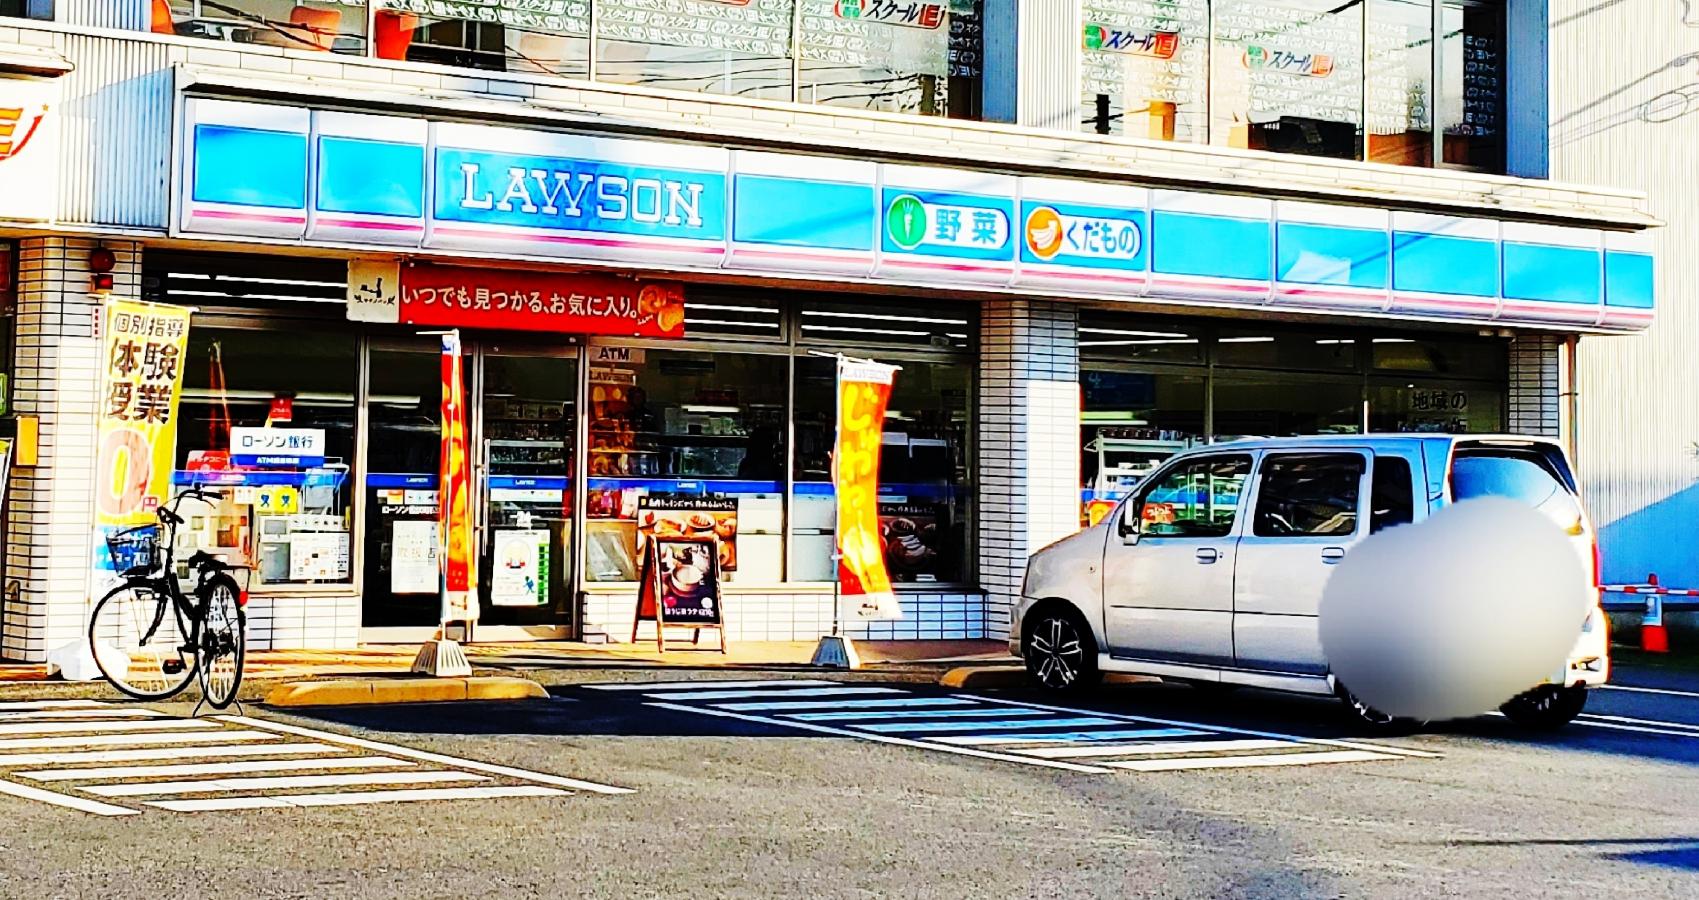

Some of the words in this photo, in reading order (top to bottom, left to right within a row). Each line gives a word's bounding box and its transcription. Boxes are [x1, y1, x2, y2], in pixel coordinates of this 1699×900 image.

[460, 162, 704, 227] LAWSON
[935, 208, 997, 244] 野菜
[1067, 222, 1136, 254] くだもの
[402, 284, 637, 319] いつでも見つかる、お気に入り。
[109, 337, 179, 380] 体験
[599, 346, 630, 360] ATM
[241, 435, 314, 450] ローソン銀行
